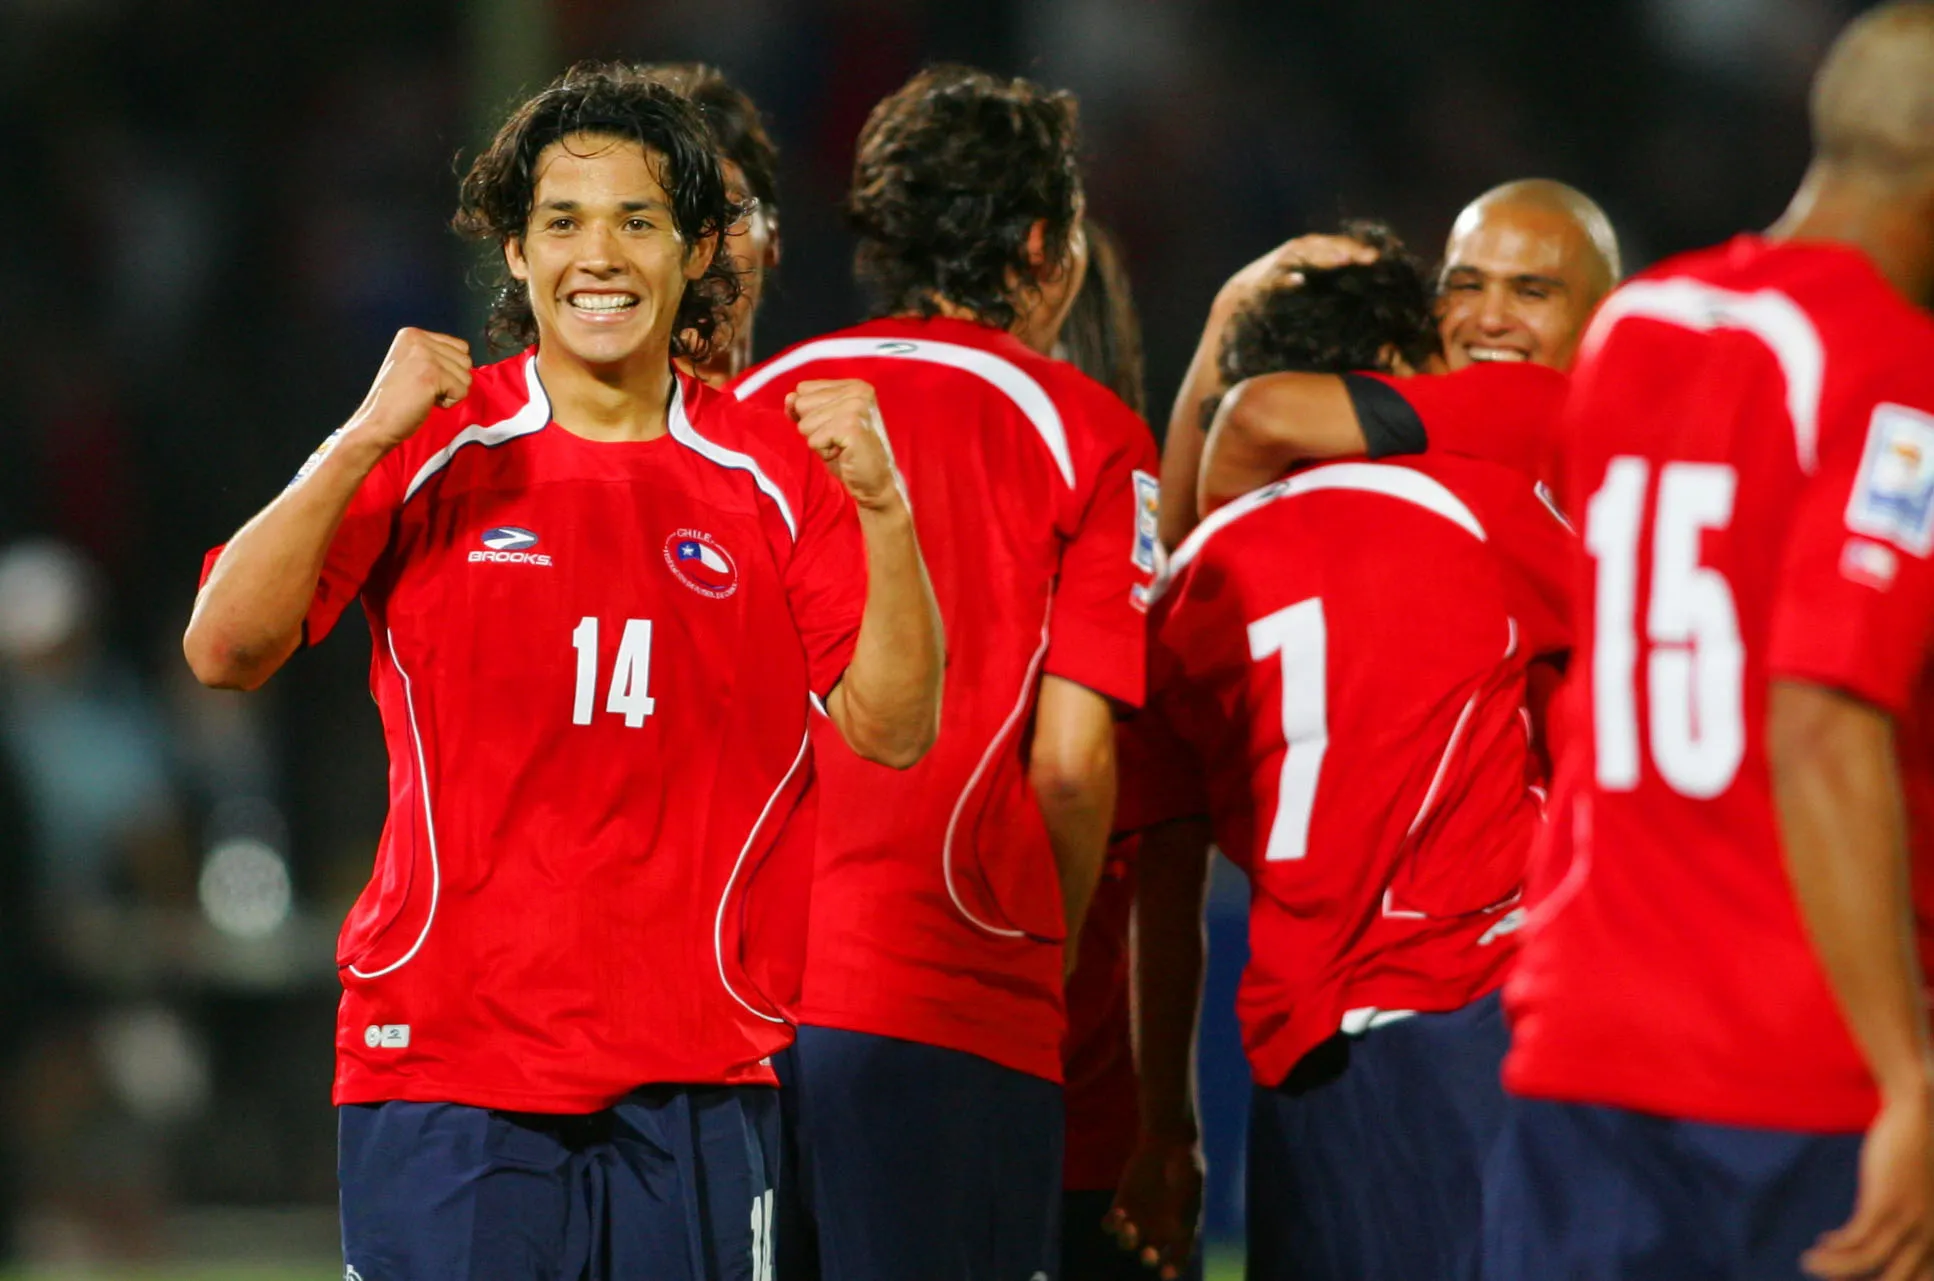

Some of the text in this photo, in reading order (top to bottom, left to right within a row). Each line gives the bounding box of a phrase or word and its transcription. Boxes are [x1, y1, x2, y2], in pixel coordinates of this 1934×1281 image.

[467, 550, 552, 567] BROOKS
[572, 616, 655, 728] 14
[1586, 455, 1746, 799] 15
